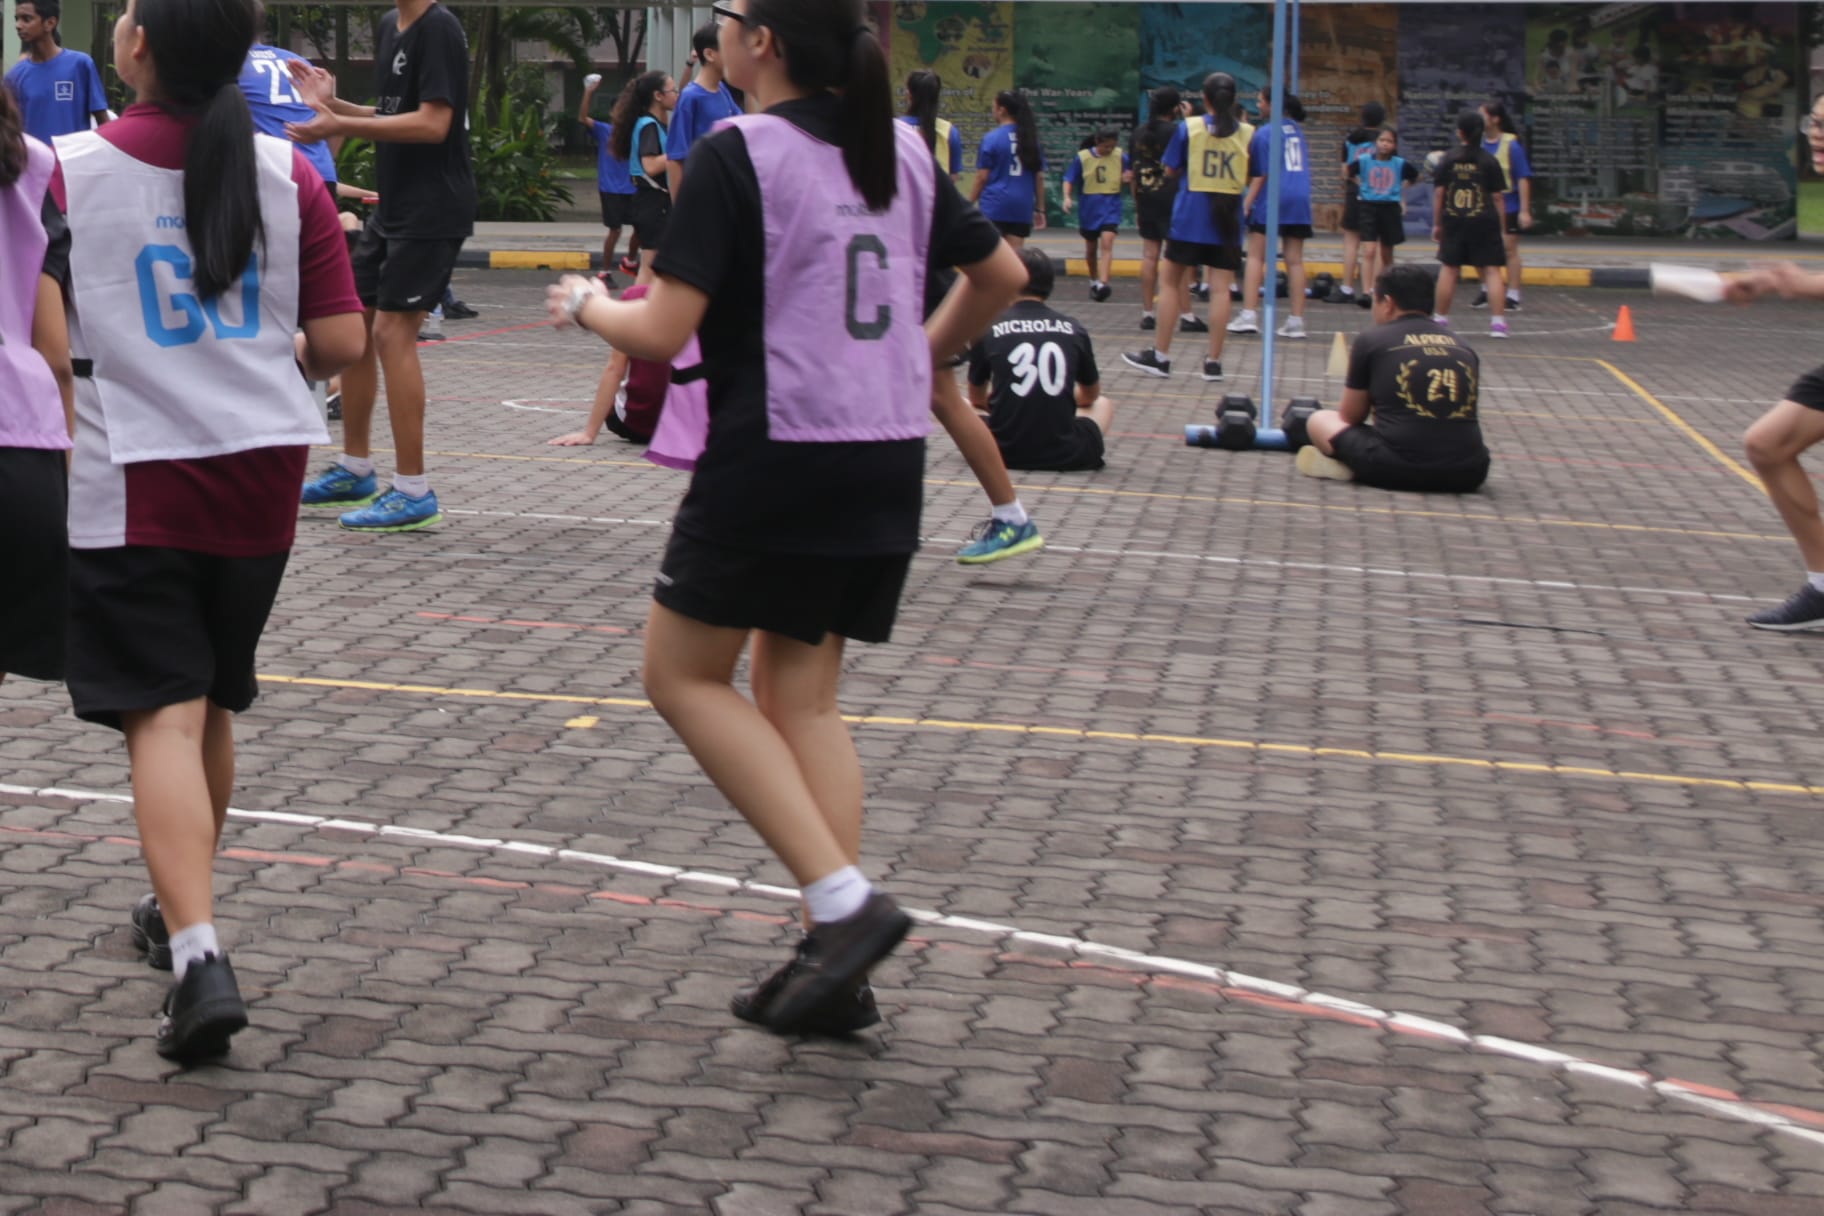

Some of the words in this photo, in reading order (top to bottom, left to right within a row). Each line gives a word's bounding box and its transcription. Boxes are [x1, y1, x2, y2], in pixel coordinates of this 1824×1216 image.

[1095, 165, 1107, 184] C
[1202, 149, 1238, 181] GK
[846, 234, 891, 340] C
[992, 319, 1074, 338] NICHOLAS
[1008, 341, 1066, 397] 30
[1427, 368, 1459, 402] 24
